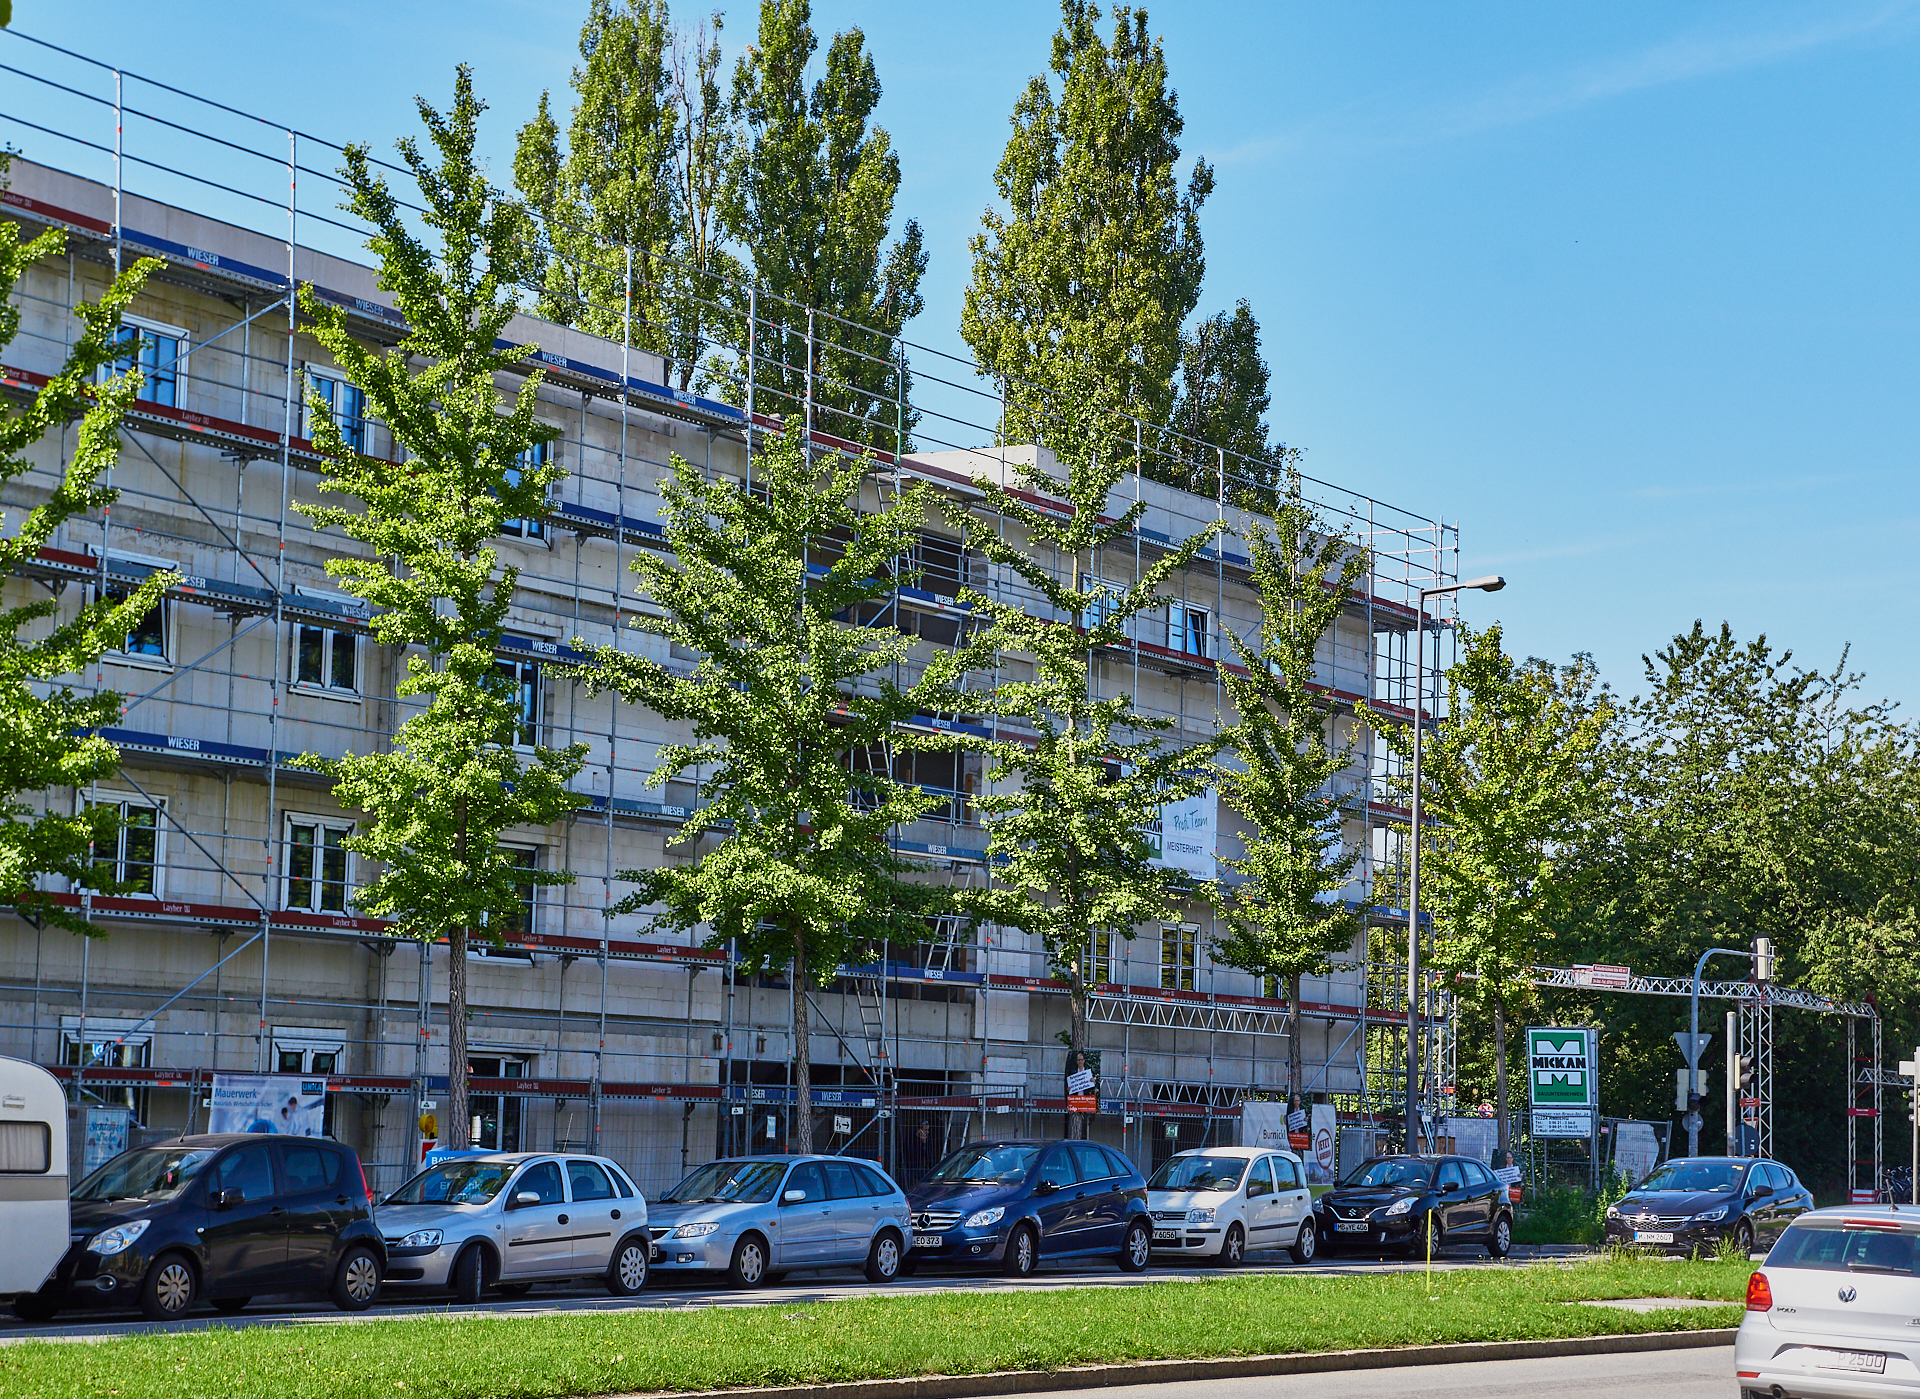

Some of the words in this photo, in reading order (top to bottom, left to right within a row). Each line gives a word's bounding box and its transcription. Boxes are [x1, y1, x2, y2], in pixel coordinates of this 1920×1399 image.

[188, 247, 219, 266] WIESER
[355, 299, 384, 316] WIESER
[542, 352, 567, 367] WIESER
[673, 390, 696, 405] WIESER
[182, 412, 203, 422] Layher
[935, 594, 954, 605] WIESER
[342, 605, 370, 619] WIESER
[532, 641, 557, 654] WIESER
[932, 719, 951, 729] WIESER
[168, 736, 200, 751] WIESER
[661, 805, 685, 817] WIESER
[1189, 809, 1208, 828] Team
[928, 844, 947, 855] WIESER
[1167, 841, 1203, 855] MEISTERHAFT
[163, 904, 182, 913] Layher
[333, 918, 351, 927] Layher
[522, 934, 539, 942] Layher
[657, 946, 672, 954] Layher
[924, 970, 944, 979] WIESER
[1532, 1056, 1586, 1069] MICKAN
[214, 1088, 257, 1098] Mauerwerk
[822, 1092, 842, 1101] WIESER
[1263, 1129, 1286, 1140] Burnickl
[1318, 1137, 1330, 1151] JETZT
[1348, 1223, 1356, 1231] YE
[1158, 1231, 1175, 1239] 6056
[1848, 1352, 1883, 1367] 2500
